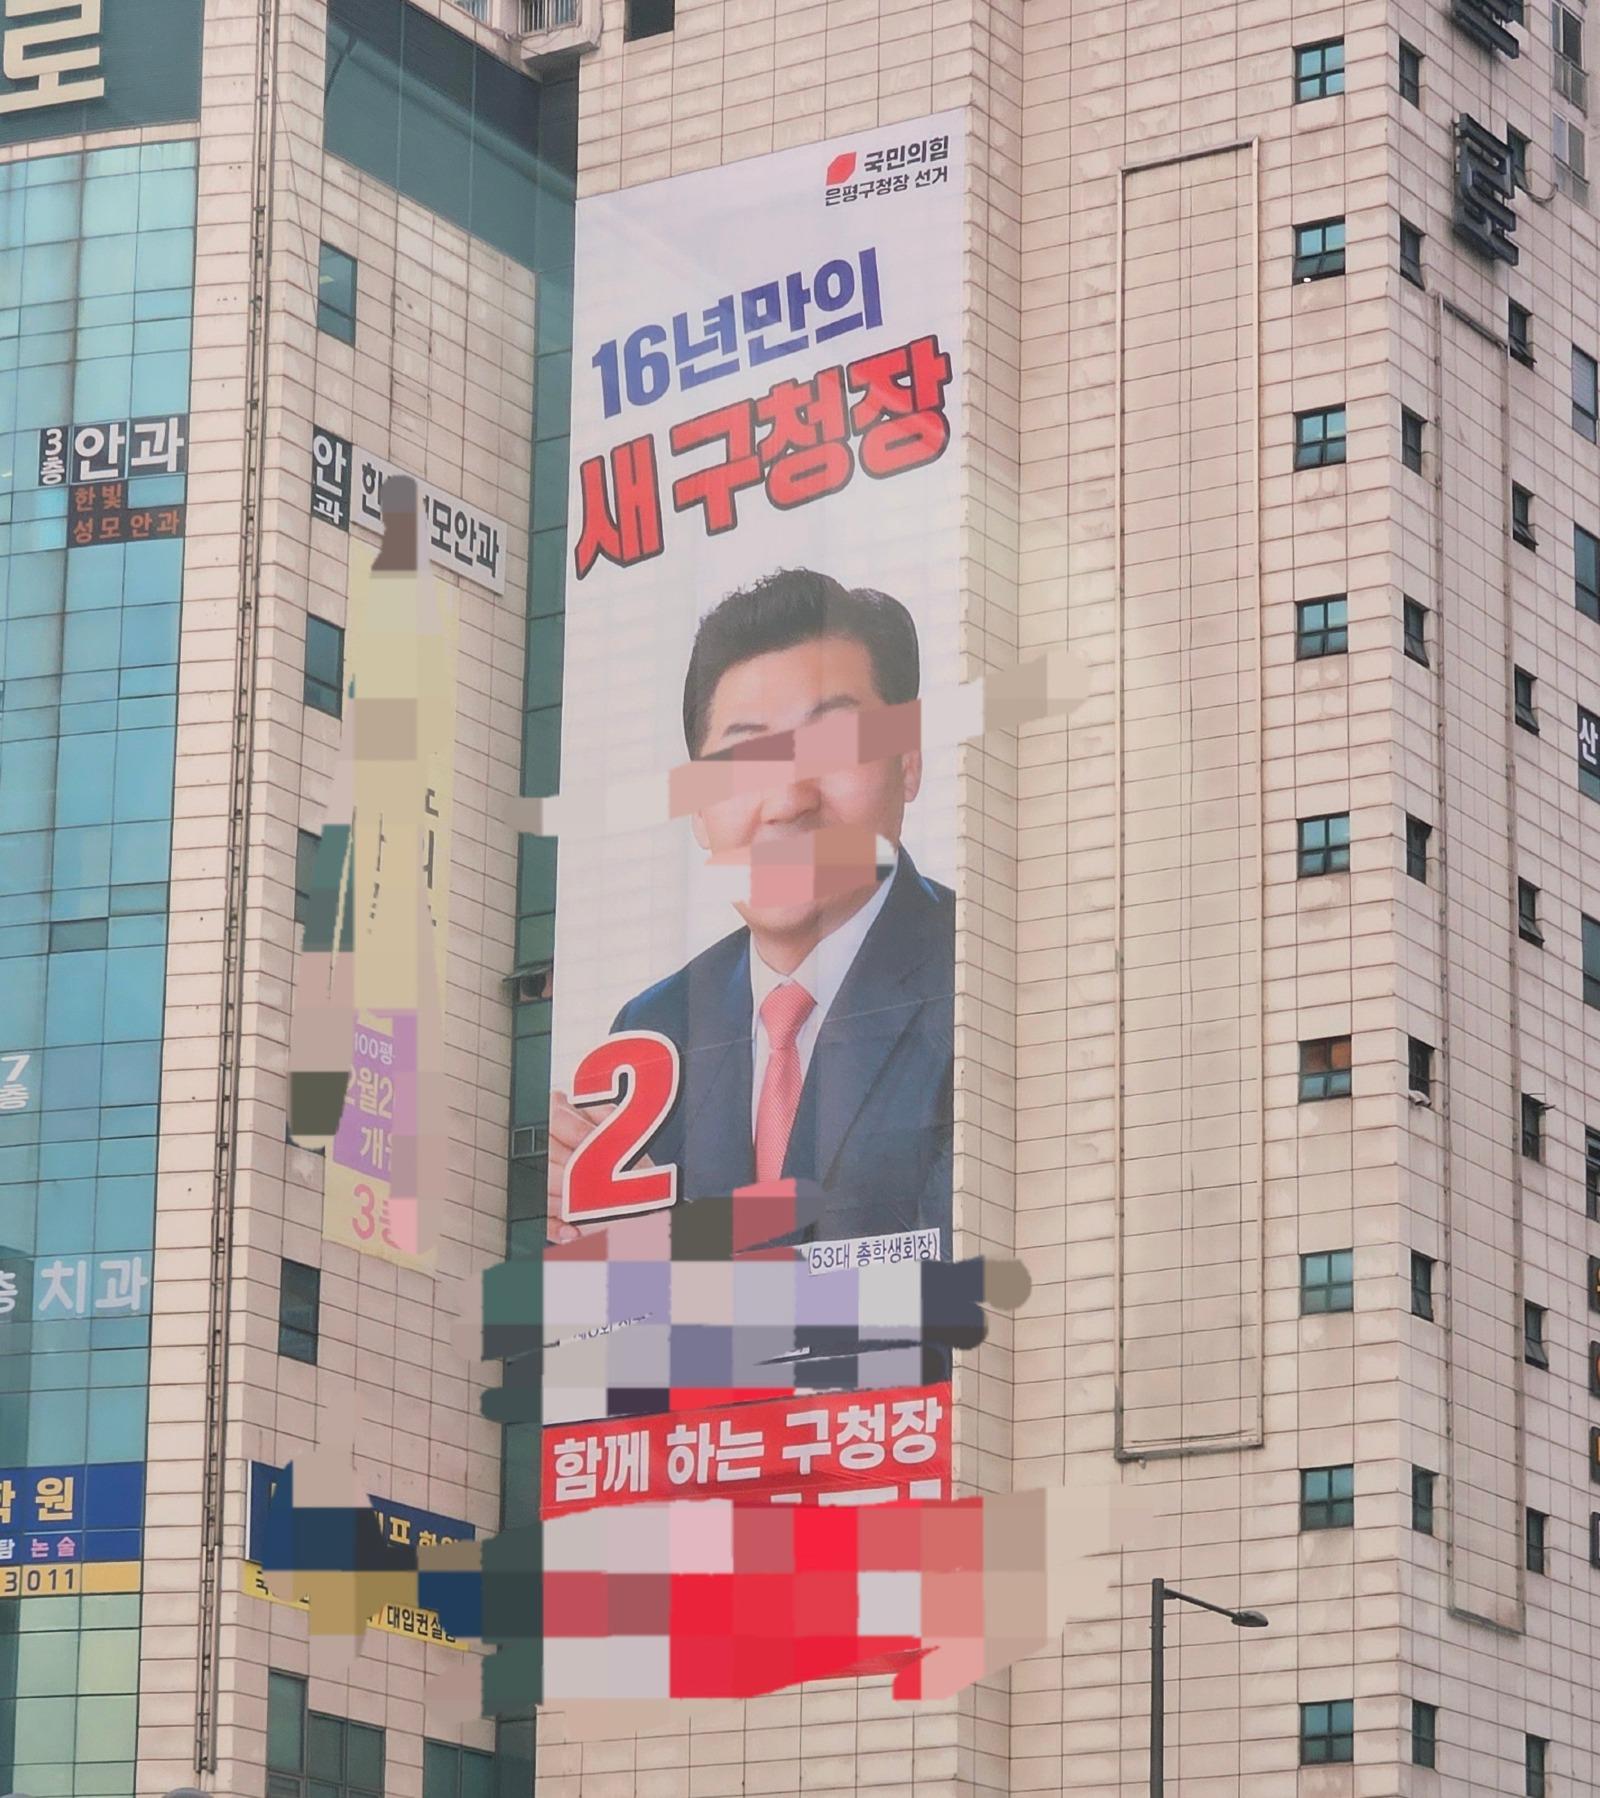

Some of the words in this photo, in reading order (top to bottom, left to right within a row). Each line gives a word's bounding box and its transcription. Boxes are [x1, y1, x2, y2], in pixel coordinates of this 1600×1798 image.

[864, 135, 949, 173] 국민의힘
[825, 173, 910, 207] 은평구청장
[914, 165, 948, 189] 선거
[592, 247, 883, 419] 16년만의
[40, 428, 65, 485] 3층
[74, 417, 185, 481] 안과
[313, 434, 348, 525] 안과
[575, 433, 664, 580] 새
[669, 334, 953, 536] 구청장
[74, 484, 123, 512] 한빛
[562, 1030, 680, 1222] 2
[807, 1243, 850, 1275] (53대
[856, 1231, 938, 1268] 총학생회장)
[38, 1256, 148, 1314] 치과
[554, 1431, 650, 1502] 함께
[666, 1420, 765, 1485] 하는
[782, 1397, 943, 1476] 구청장
